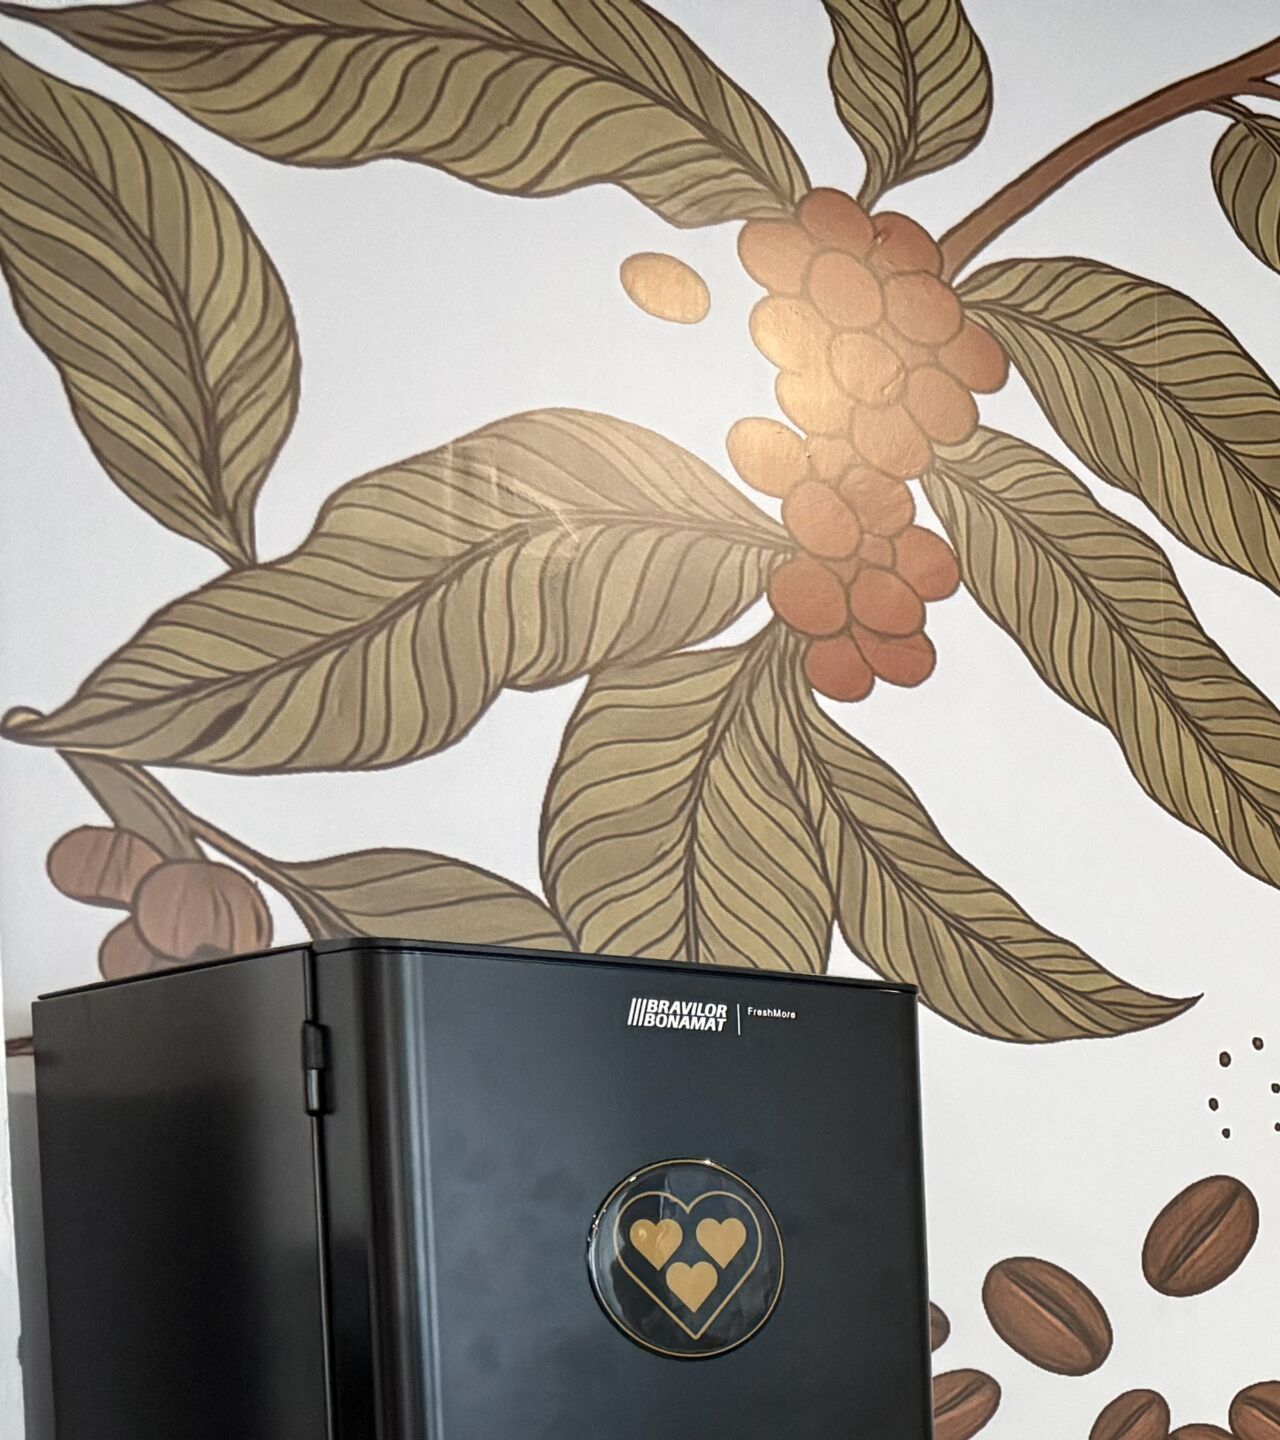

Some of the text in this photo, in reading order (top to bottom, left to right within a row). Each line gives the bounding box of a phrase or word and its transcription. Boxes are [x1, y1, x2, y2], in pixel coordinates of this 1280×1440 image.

[646, 999, 728, 1018] BRAVILOR
[747, 1006, 797, 1020] FreshMore
[643, 1013, 728, 1032] BONAMAT
